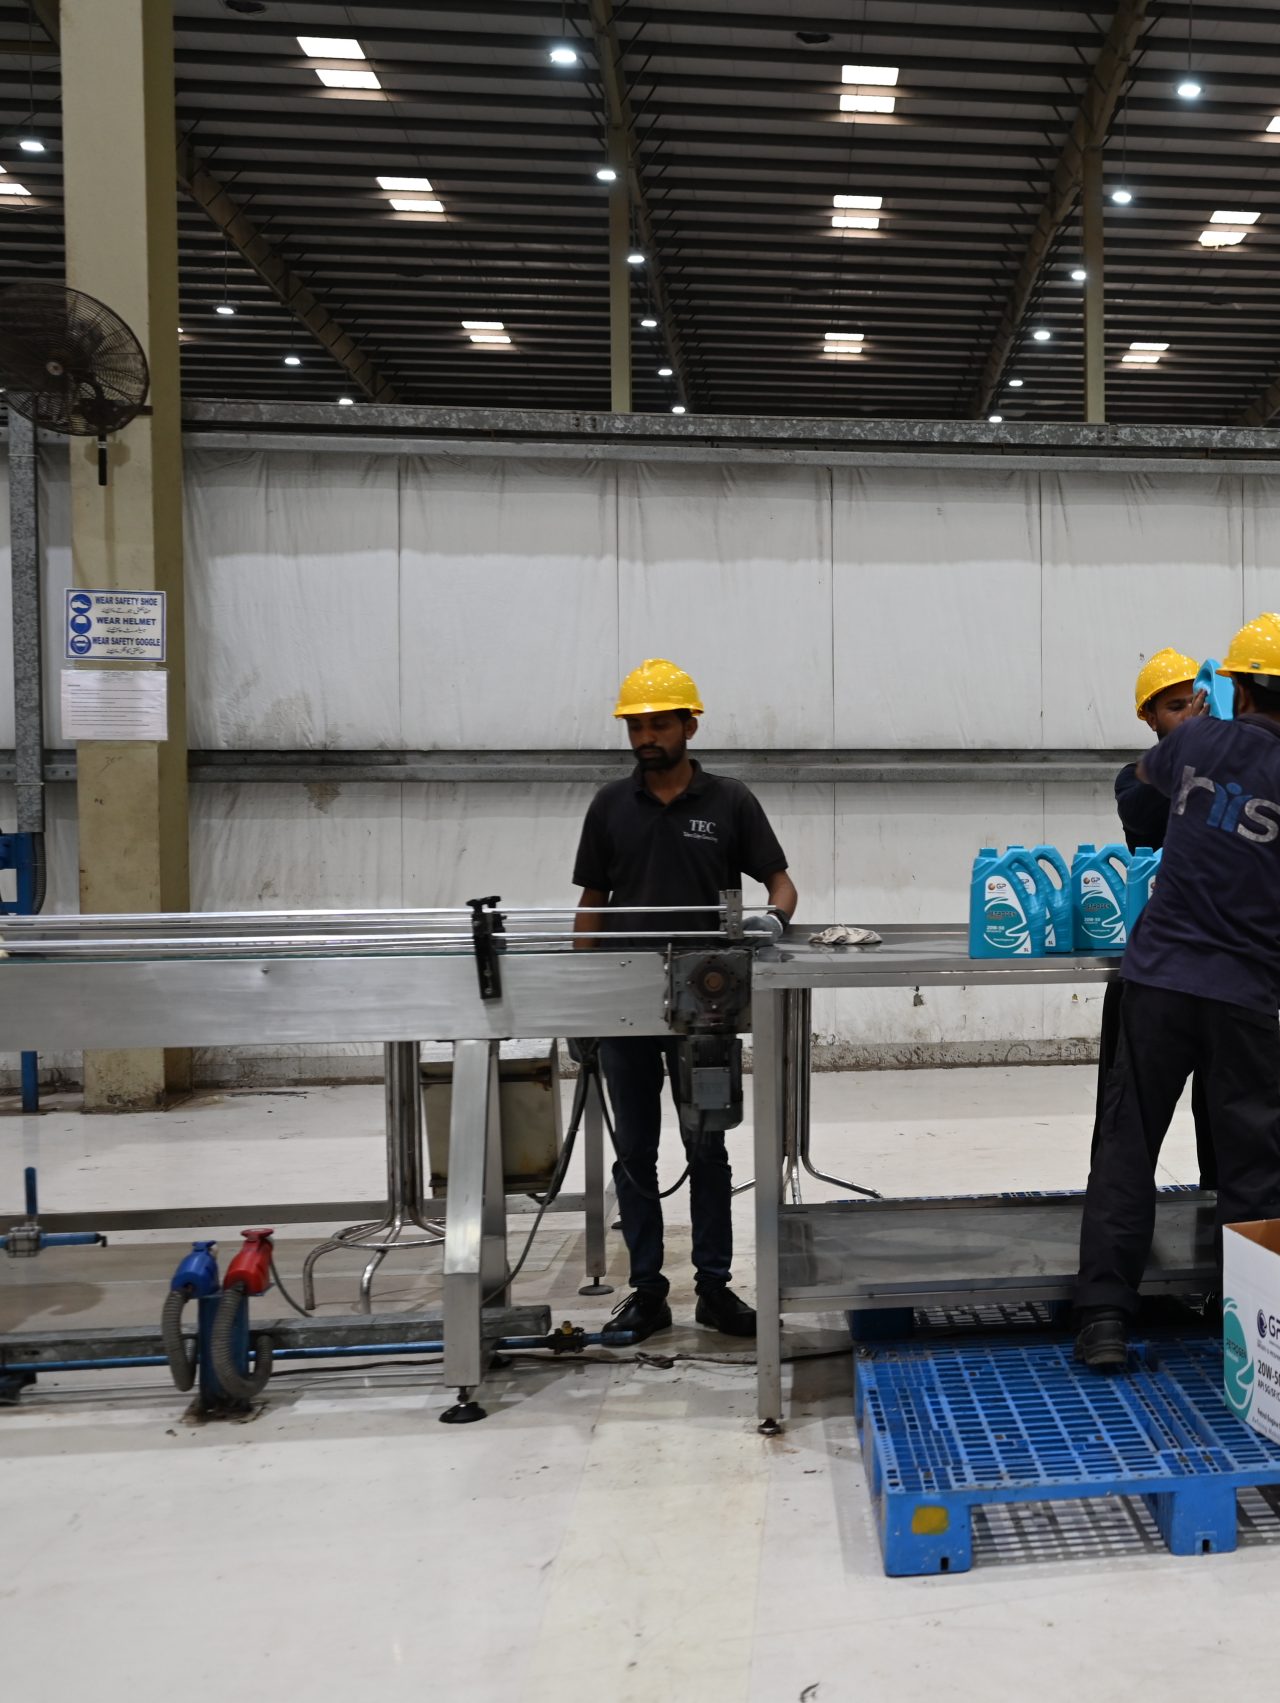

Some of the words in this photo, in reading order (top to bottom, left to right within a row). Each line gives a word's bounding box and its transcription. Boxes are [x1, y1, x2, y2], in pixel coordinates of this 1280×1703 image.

[96, 596, 113, 604] WEAR
[115, 597, 139, 605] SAFETY
[92, 637, 110, 645] WEAR
[111, 638, 134, 646] SAFETY
[136, 638, 160, 646] GOGGLE
[689, 820, 716, 834] TEC
